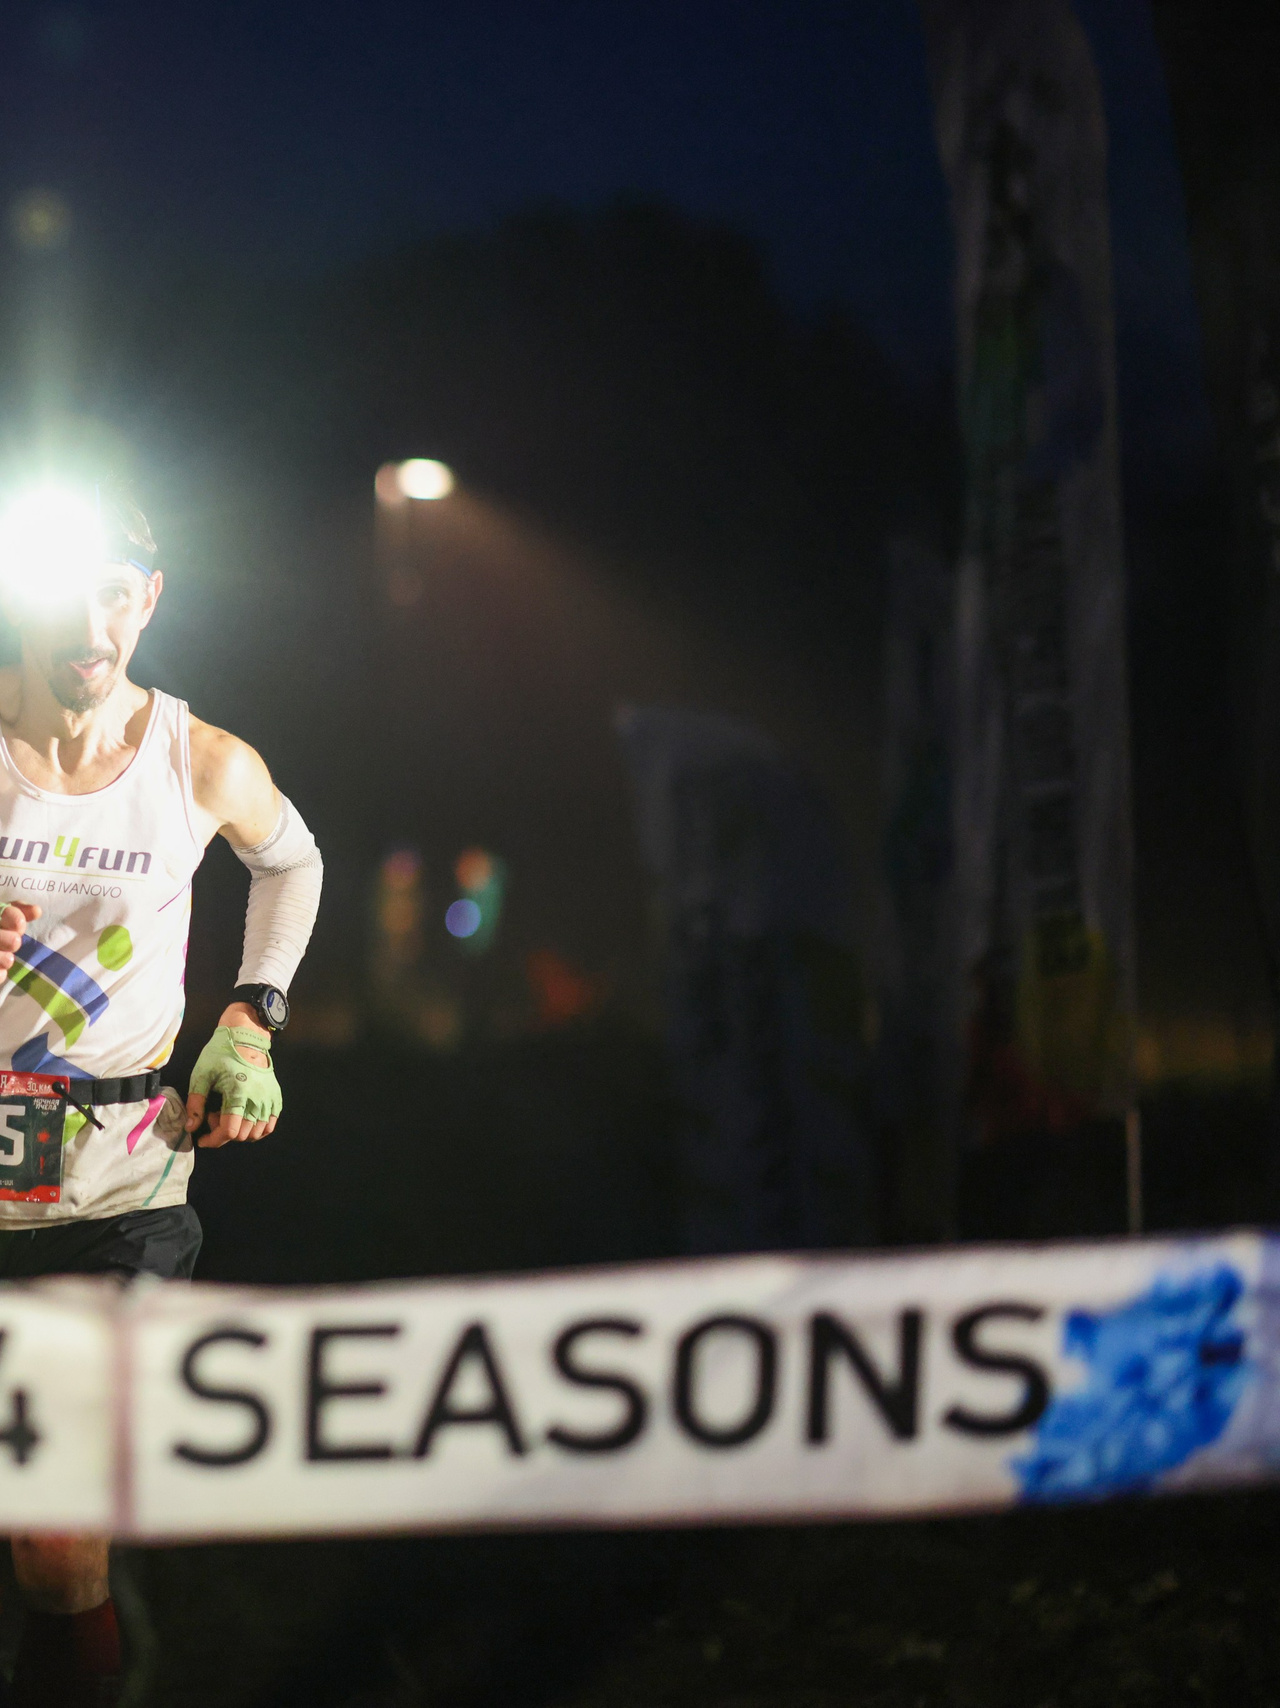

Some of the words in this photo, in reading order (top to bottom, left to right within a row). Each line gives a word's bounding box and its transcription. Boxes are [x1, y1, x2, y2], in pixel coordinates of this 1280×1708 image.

[21, 877, 55, 892] CLUB
[58, 881, 122, 899] IVANOVO
[172, 1302, 1054, 1468] SEASONS
